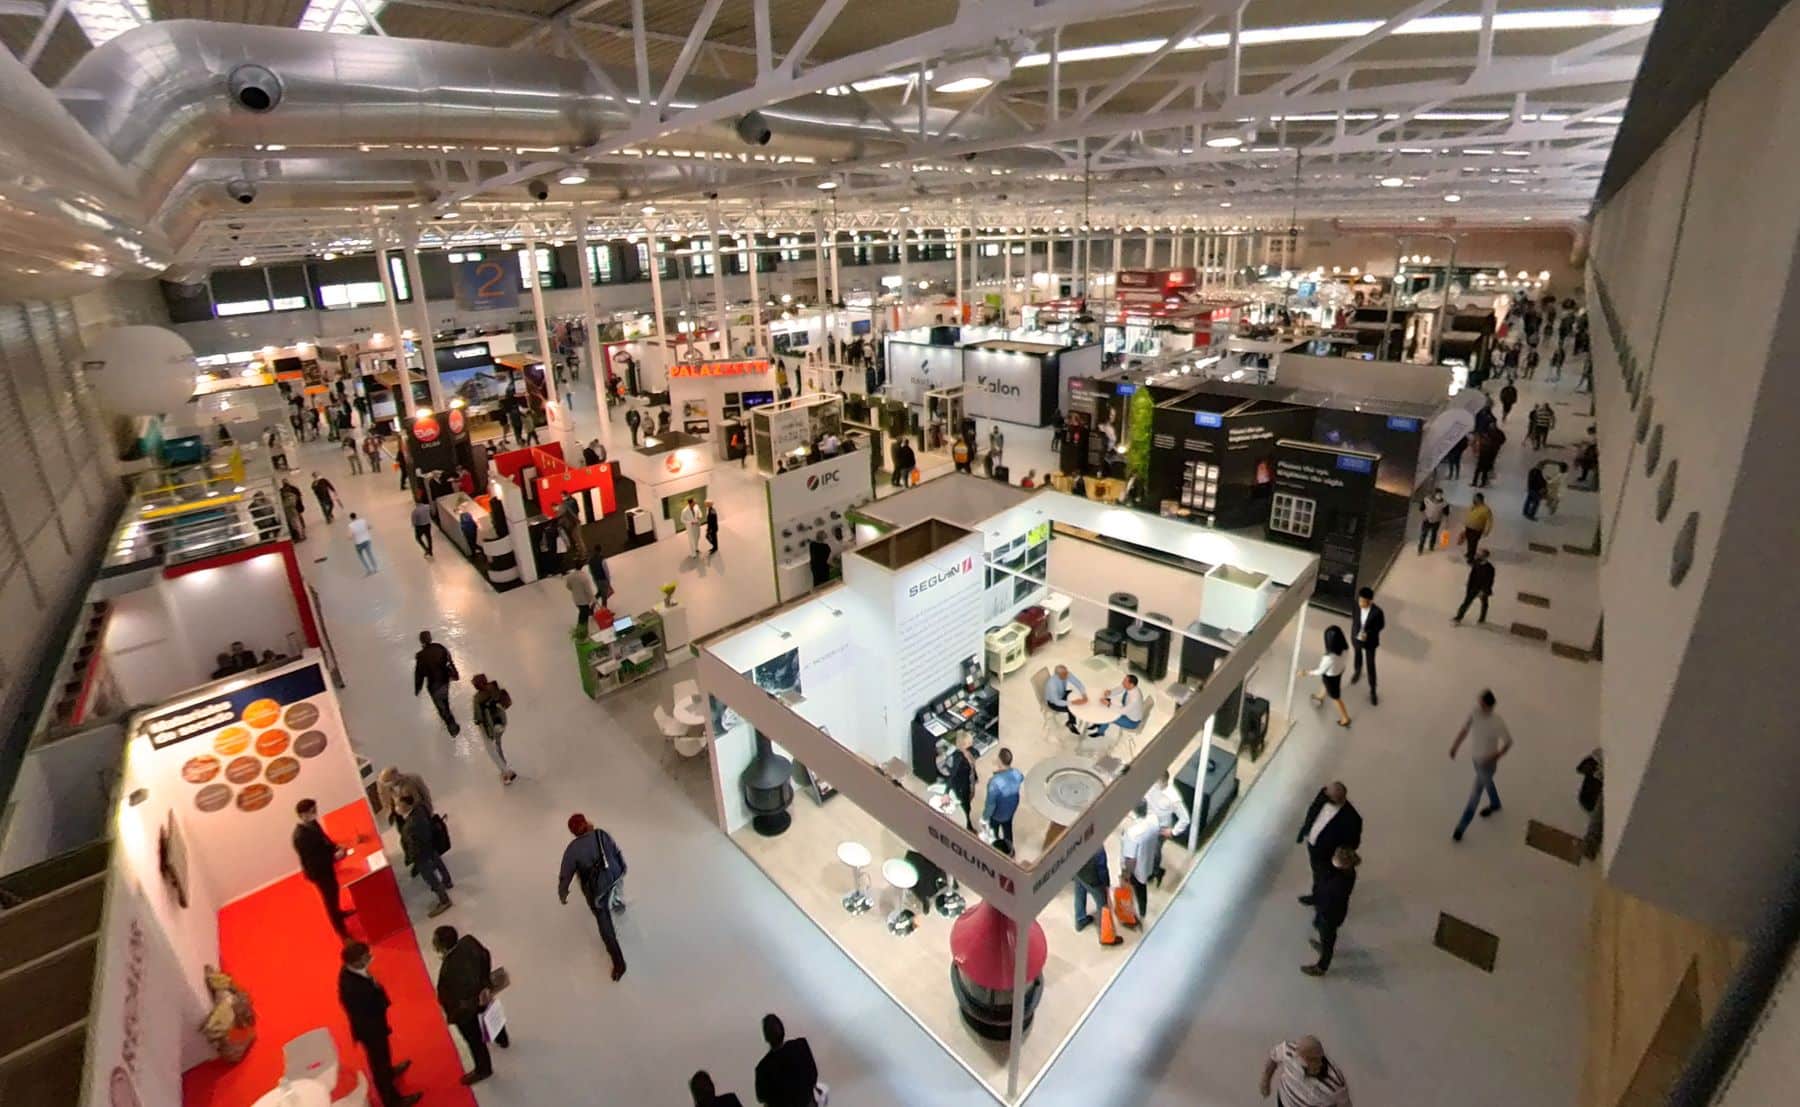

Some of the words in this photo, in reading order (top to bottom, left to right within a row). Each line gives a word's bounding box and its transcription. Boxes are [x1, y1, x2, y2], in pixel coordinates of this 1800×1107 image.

[475, 262, 505, 297] 2
[977, 375, 1020, 396] Kalon
[820, 470, 841, 487] IPC
[908, 563, 961, 598] SEGUIN
[927, 825, 997, 880] SEGUIN
[1032, 834, 1084, 896] SEGUIN
